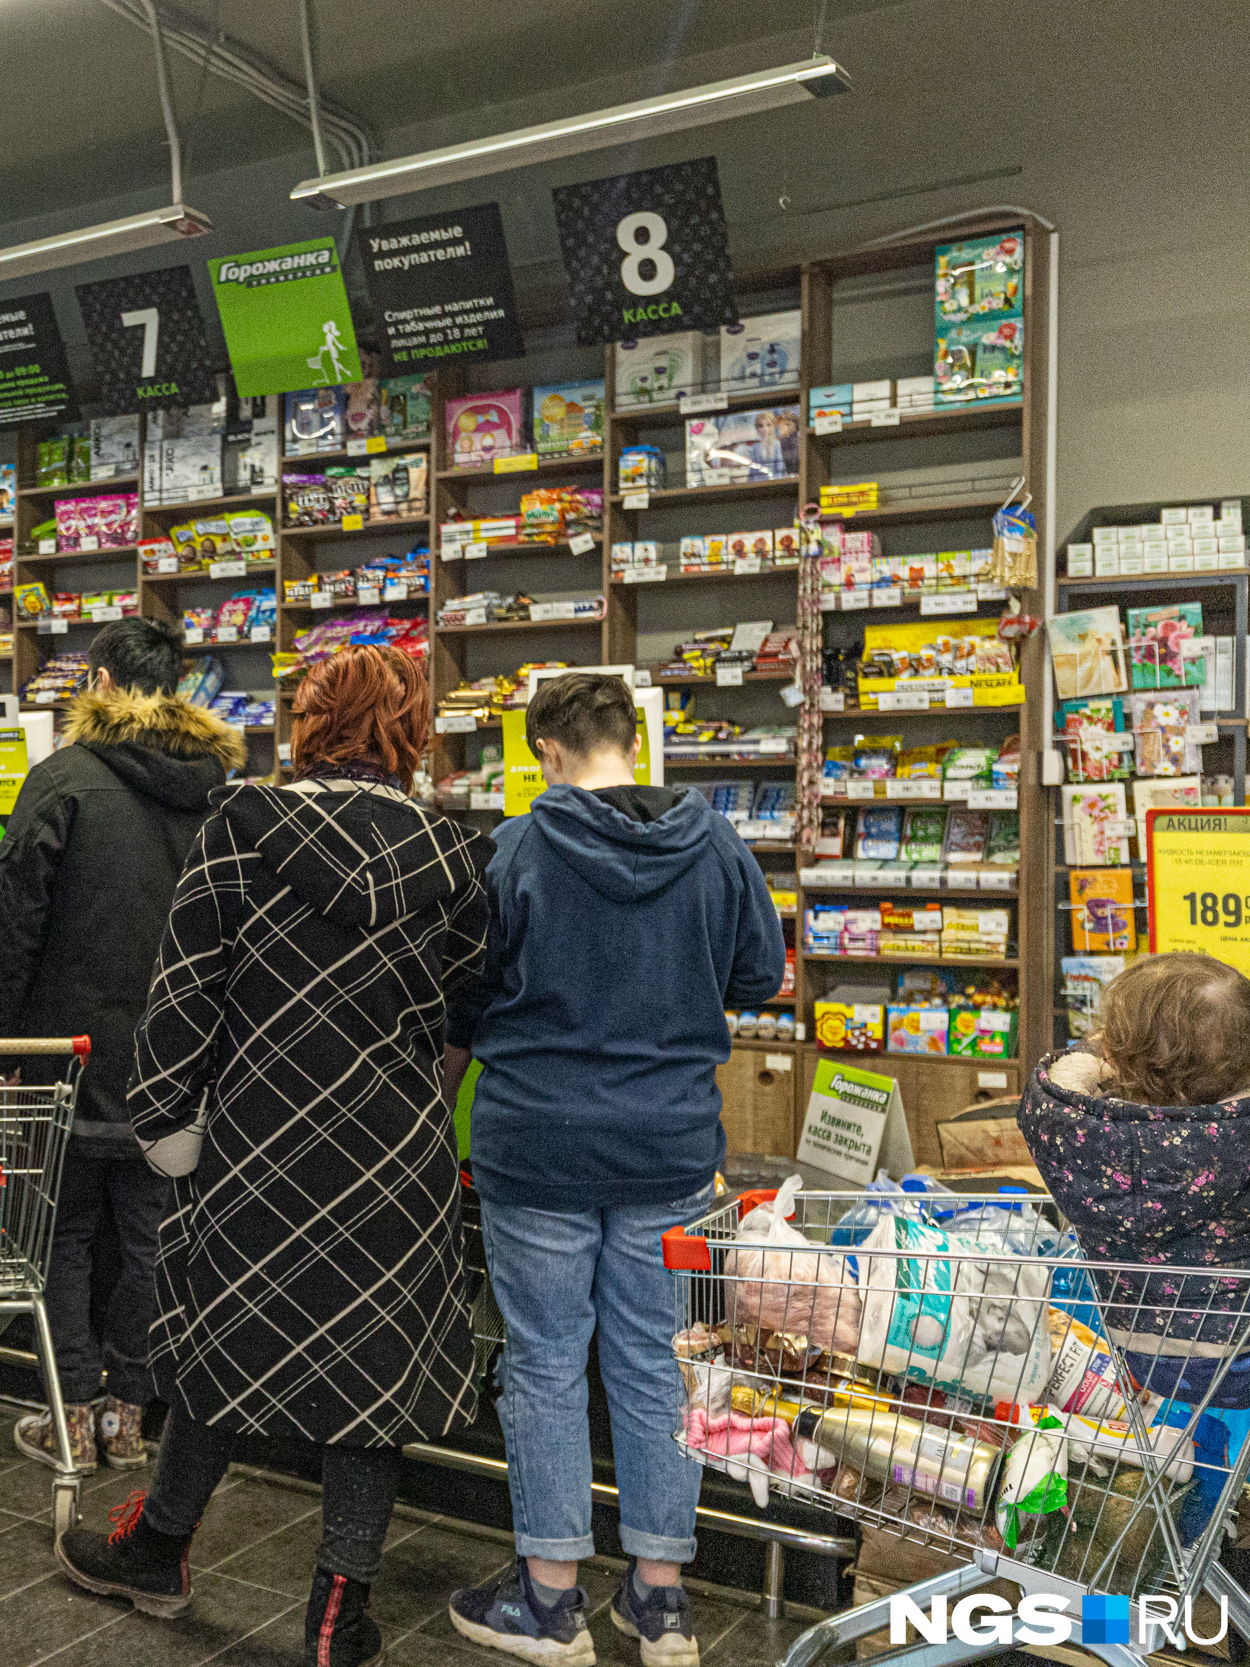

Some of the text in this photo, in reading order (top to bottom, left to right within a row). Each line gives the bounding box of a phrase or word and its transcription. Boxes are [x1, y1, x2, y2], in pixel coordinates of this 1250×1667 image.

[369, 225, 464, 253] Уважаемые
[219, 249, 331, 283] Горожанка
[373, 241, 472, 272] покупатели!
[615, 211, 676, 296] 8
[384, 296, 495, 323] Спиртные напитки
[387, 308, 505, 335] и табачные изделия
[623, 301, 683, 324] КАССА
[120, 308, 159, 378] 7
[391, 326, 485, 349] лицам до 18 лет
[393, 338, 489, 362] НЕ ПРОДАЮТСЯ!
[137, 382, 179, 399] КАССА
[523, 774, 537, 783] НЕ
[1166, 818, 1228, 832] АКЦИЯ!
[1183, 892, 1243, 928] 189
[830, 1074, 888, 1104] Горожанка
[820, 1109, 864, 1138] Извините,
[808, 1124, 872, 1156] касса закрыта
[1044, 1353, 1076, 1397] PERFECT
[1079, 1372, 1096, 1393] adult
[500, 1604, 522, 1618] FILA
